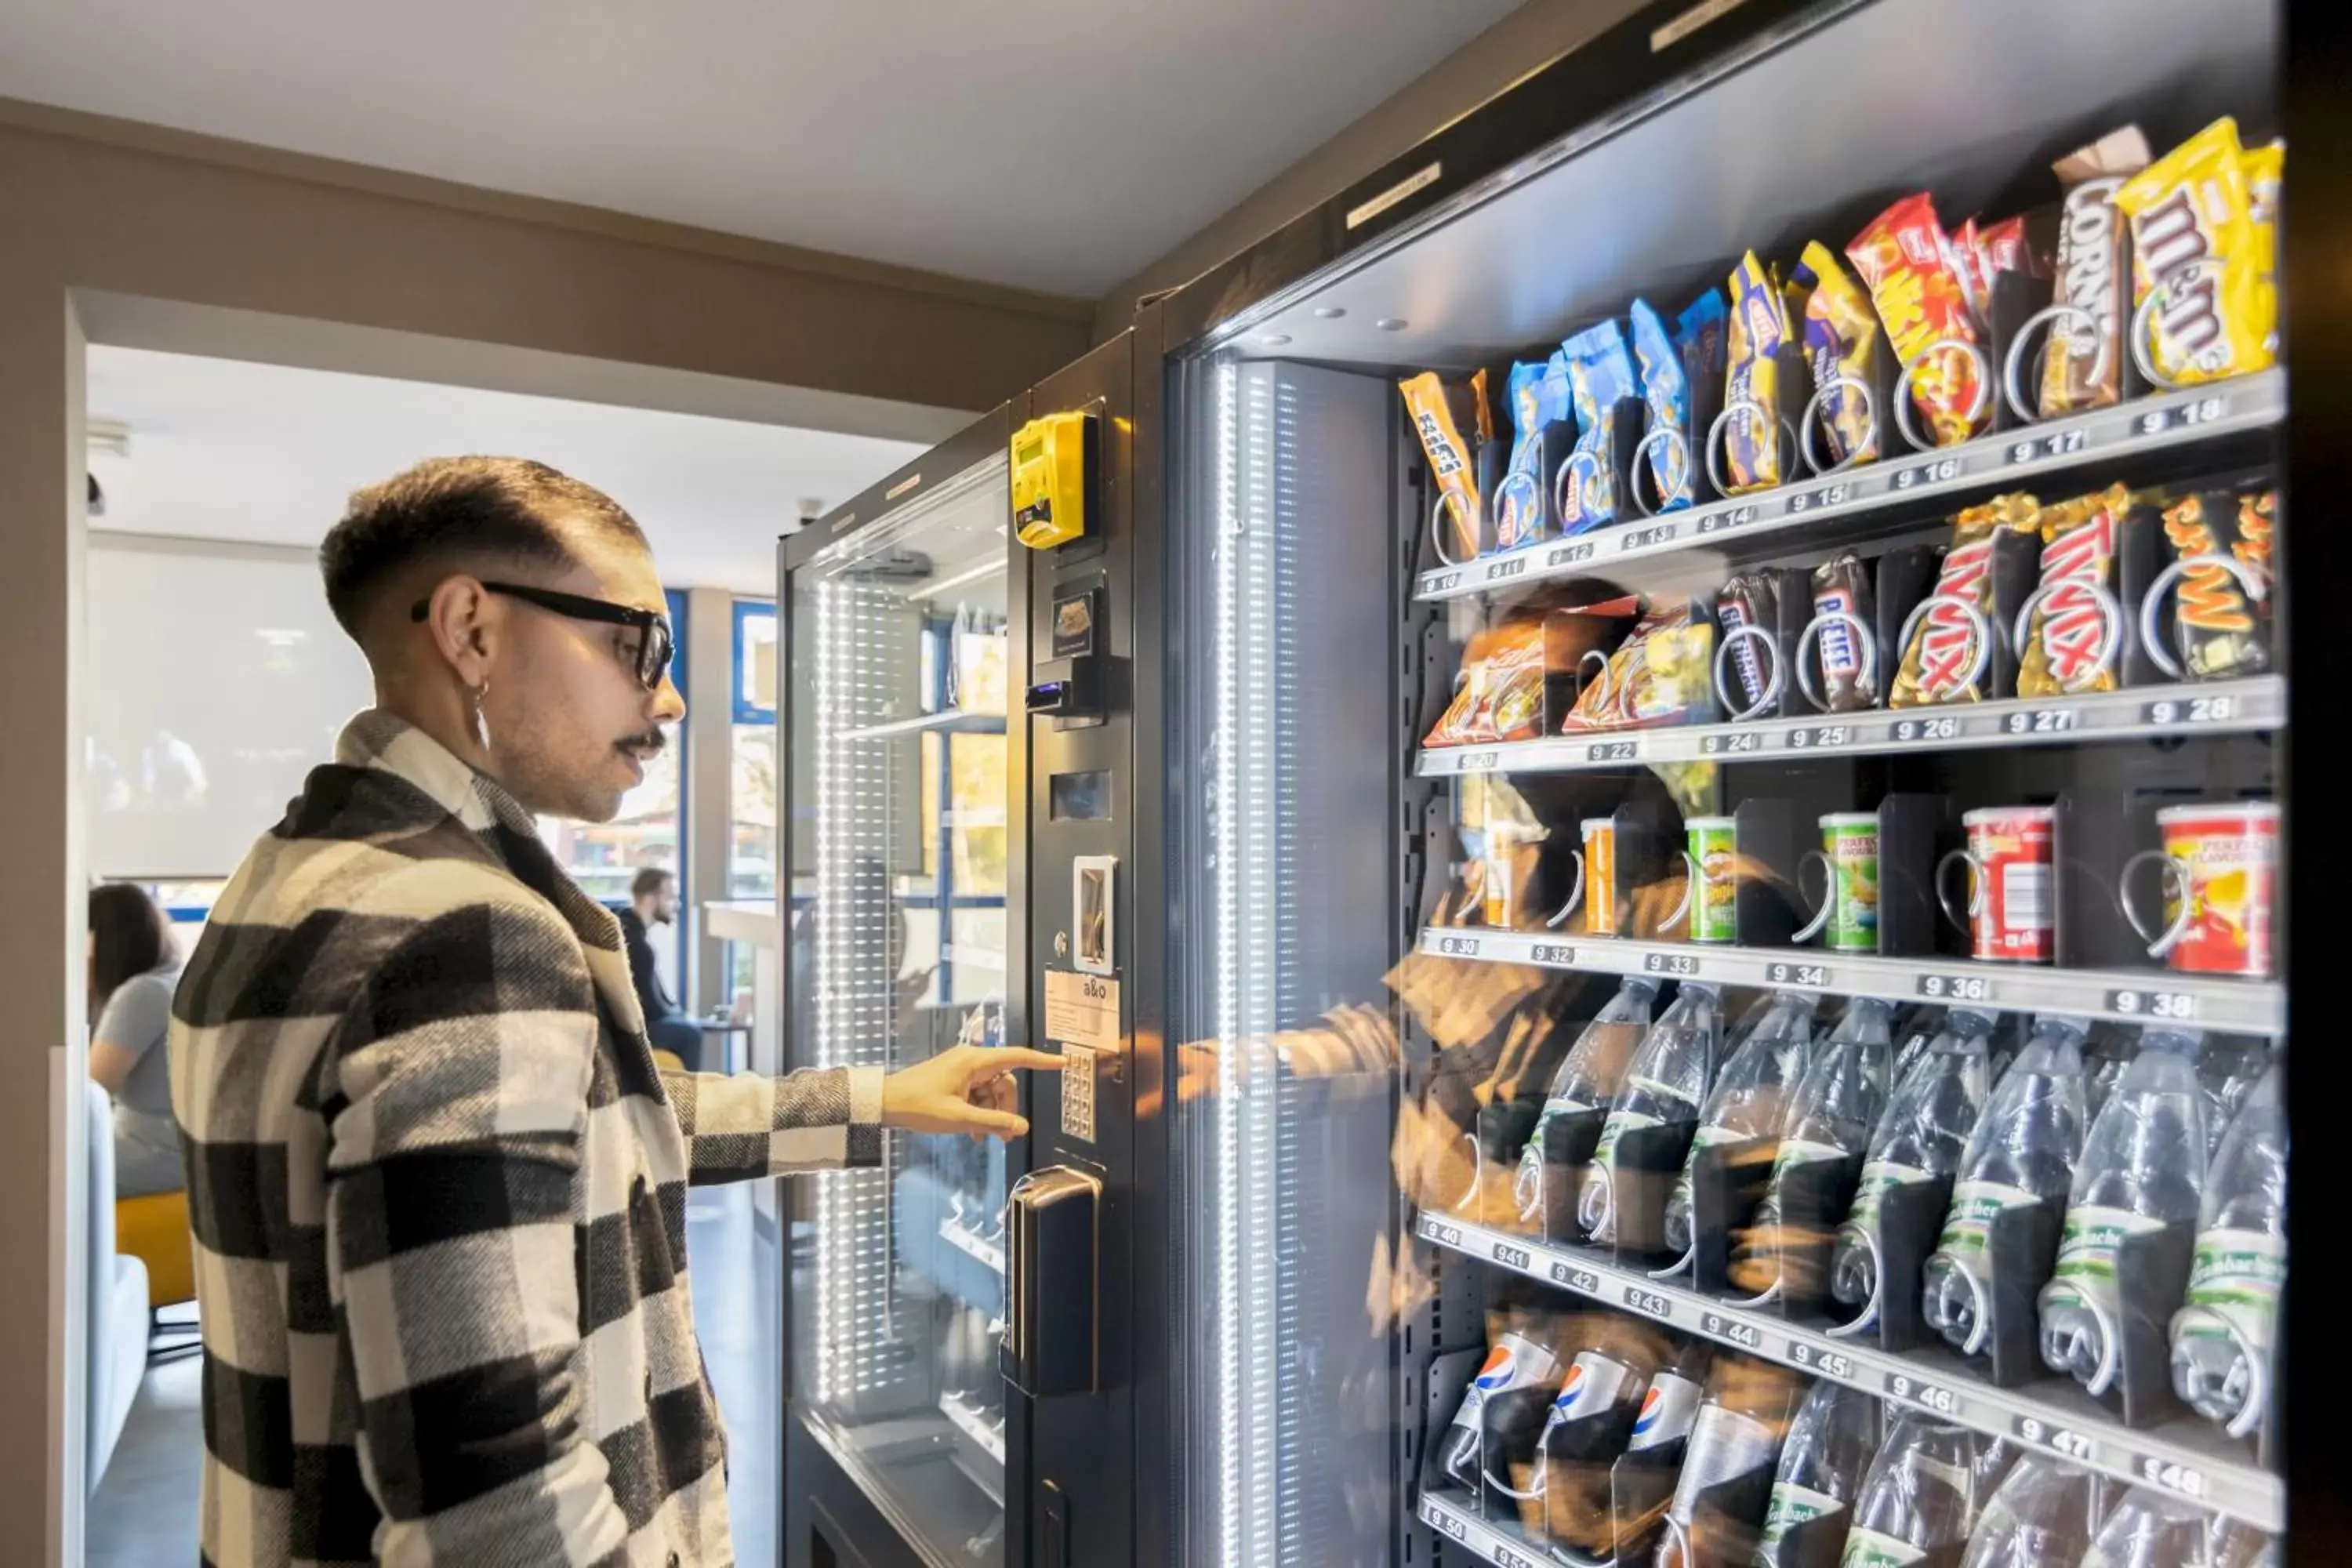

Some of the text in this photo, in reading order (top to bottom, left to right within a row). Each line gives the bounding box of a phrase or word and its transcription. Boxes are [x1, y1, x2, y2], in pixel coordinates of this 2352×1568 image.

[2143, 401, 2220, 433] 9 18
[2015, 430, 2082, 462] 9 17
[1897, 462, 1955, 488] 9 16
[1794, 486, 1843, 511] 9 15
[1704, 509, 1748, 530] 9 14
[1627, 533, 1638, 548] 9
[1552, 551, 1562, 564] 9
[1426, 575, 1457, 592] 9 10
[2010, 711, 2071, 732] 9 27
[2152, 699, 2230, 724] 9 28
[1794, 728, 1846, 746] 9 25
[1898, 720, 1955, 740] 9 26
[1592, 745, 1631, 759] 9 22
[1705, 735, 1751, 751] 9 24
[1463, 756, 1472, 768] 9
[1445, 940, 1475, 954] 9 30
[1536, 947, 1569, 962] 9 32
[1651, 956, 1690, 973] 9 33
[1774, 965, 1824, 985] 9 34
[1083, 978, 1105, 998] a&o
[1926, 976, 1982, 998] 9 36
[2117, 992, 2192, 1018] 9 38
[1428, 1224, 1457, 1243] 9 40
[1556, 1266, 1592, 1289] 9 42
[1708, 1317, 1754, 1346] 9 44
[1795, 1345, 1847, 1375] 9 45
[1893, 1377, 1950, 1410] 9 46
[2022, 1419, 2089, 1456] 9 47
[1432, 1512, 1462, 1538] 9 50
[1498, 1550, 1508, 1564] 9
